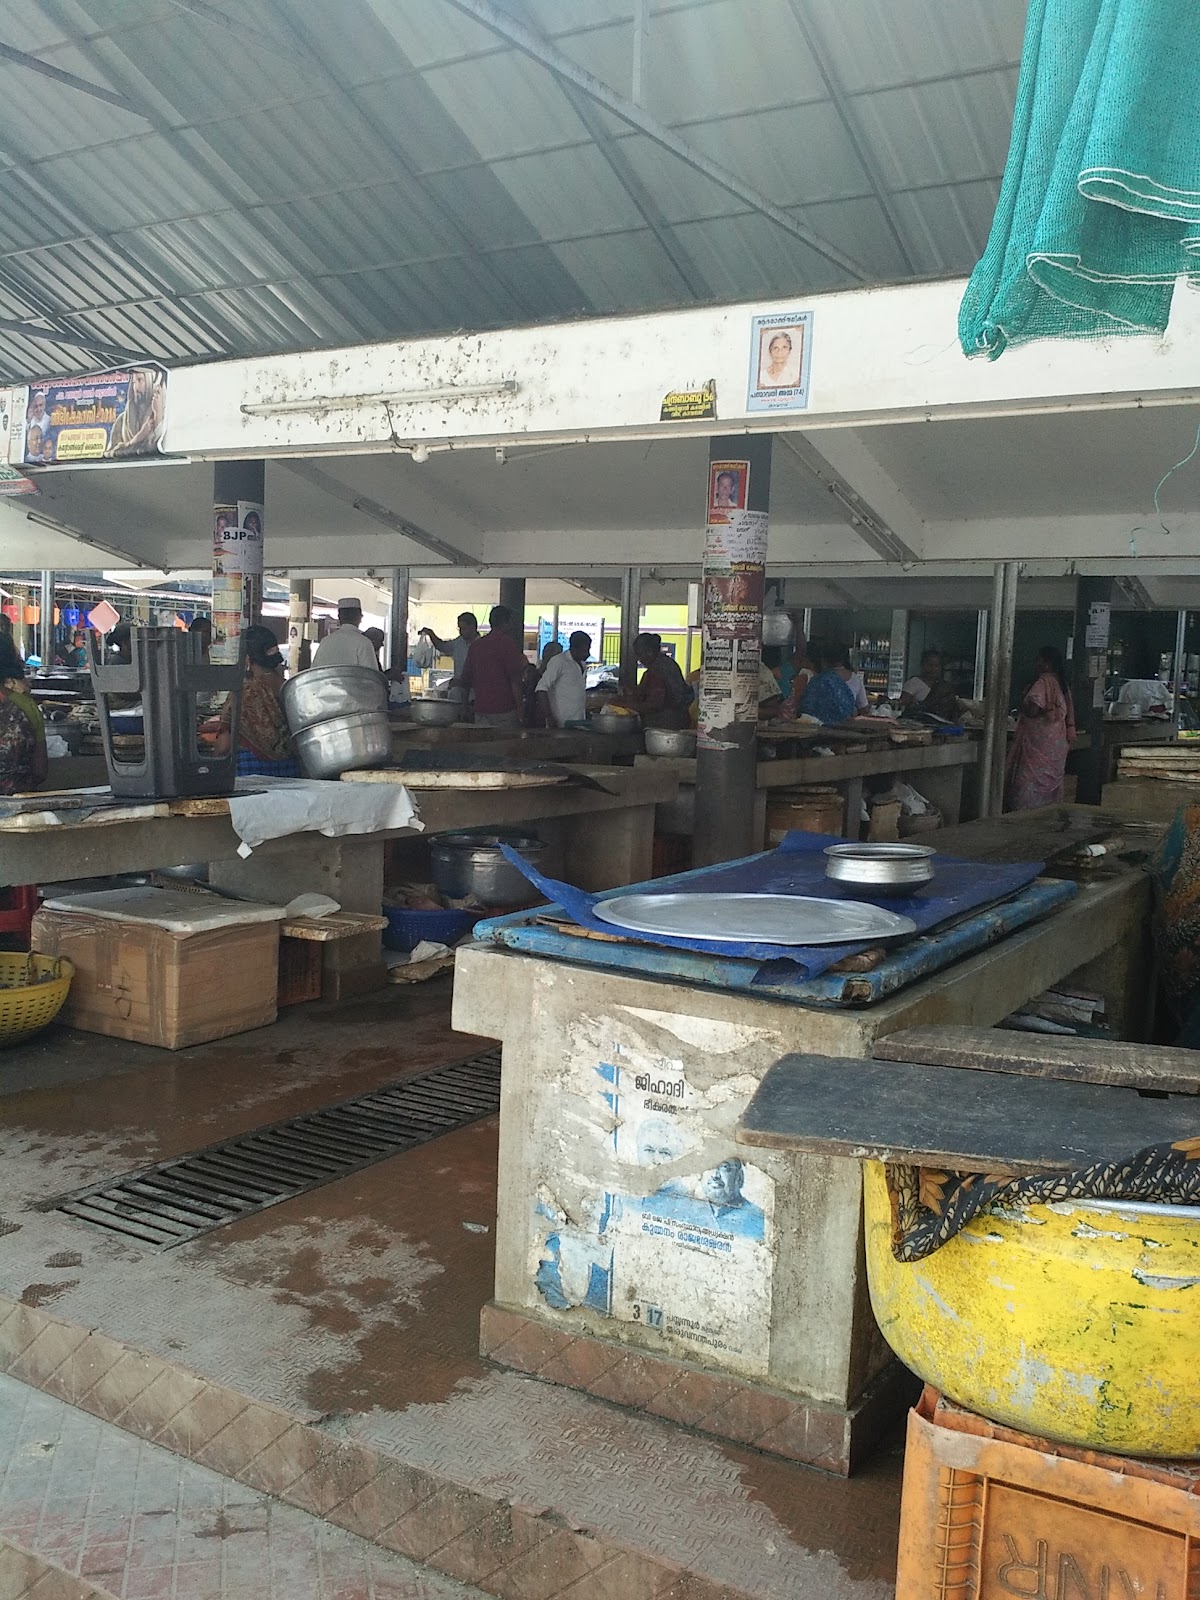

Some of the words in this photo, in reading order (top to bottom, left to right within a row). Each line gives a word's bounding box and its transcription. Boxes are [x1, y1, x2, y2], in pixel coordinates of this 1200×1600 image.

[635, 1073, 684, 1098] ജിഹാദി
[642, 1222, 675, 1238] കുമ്മനം
[677, 1231, 732, 1252] രാജശേഖരൻ
[633, 1304, 641, 1319] 3
[647, 1308, 662, 1325] 17
[666, 1325, 728, 1350] തിരുവനന്തപുരം
